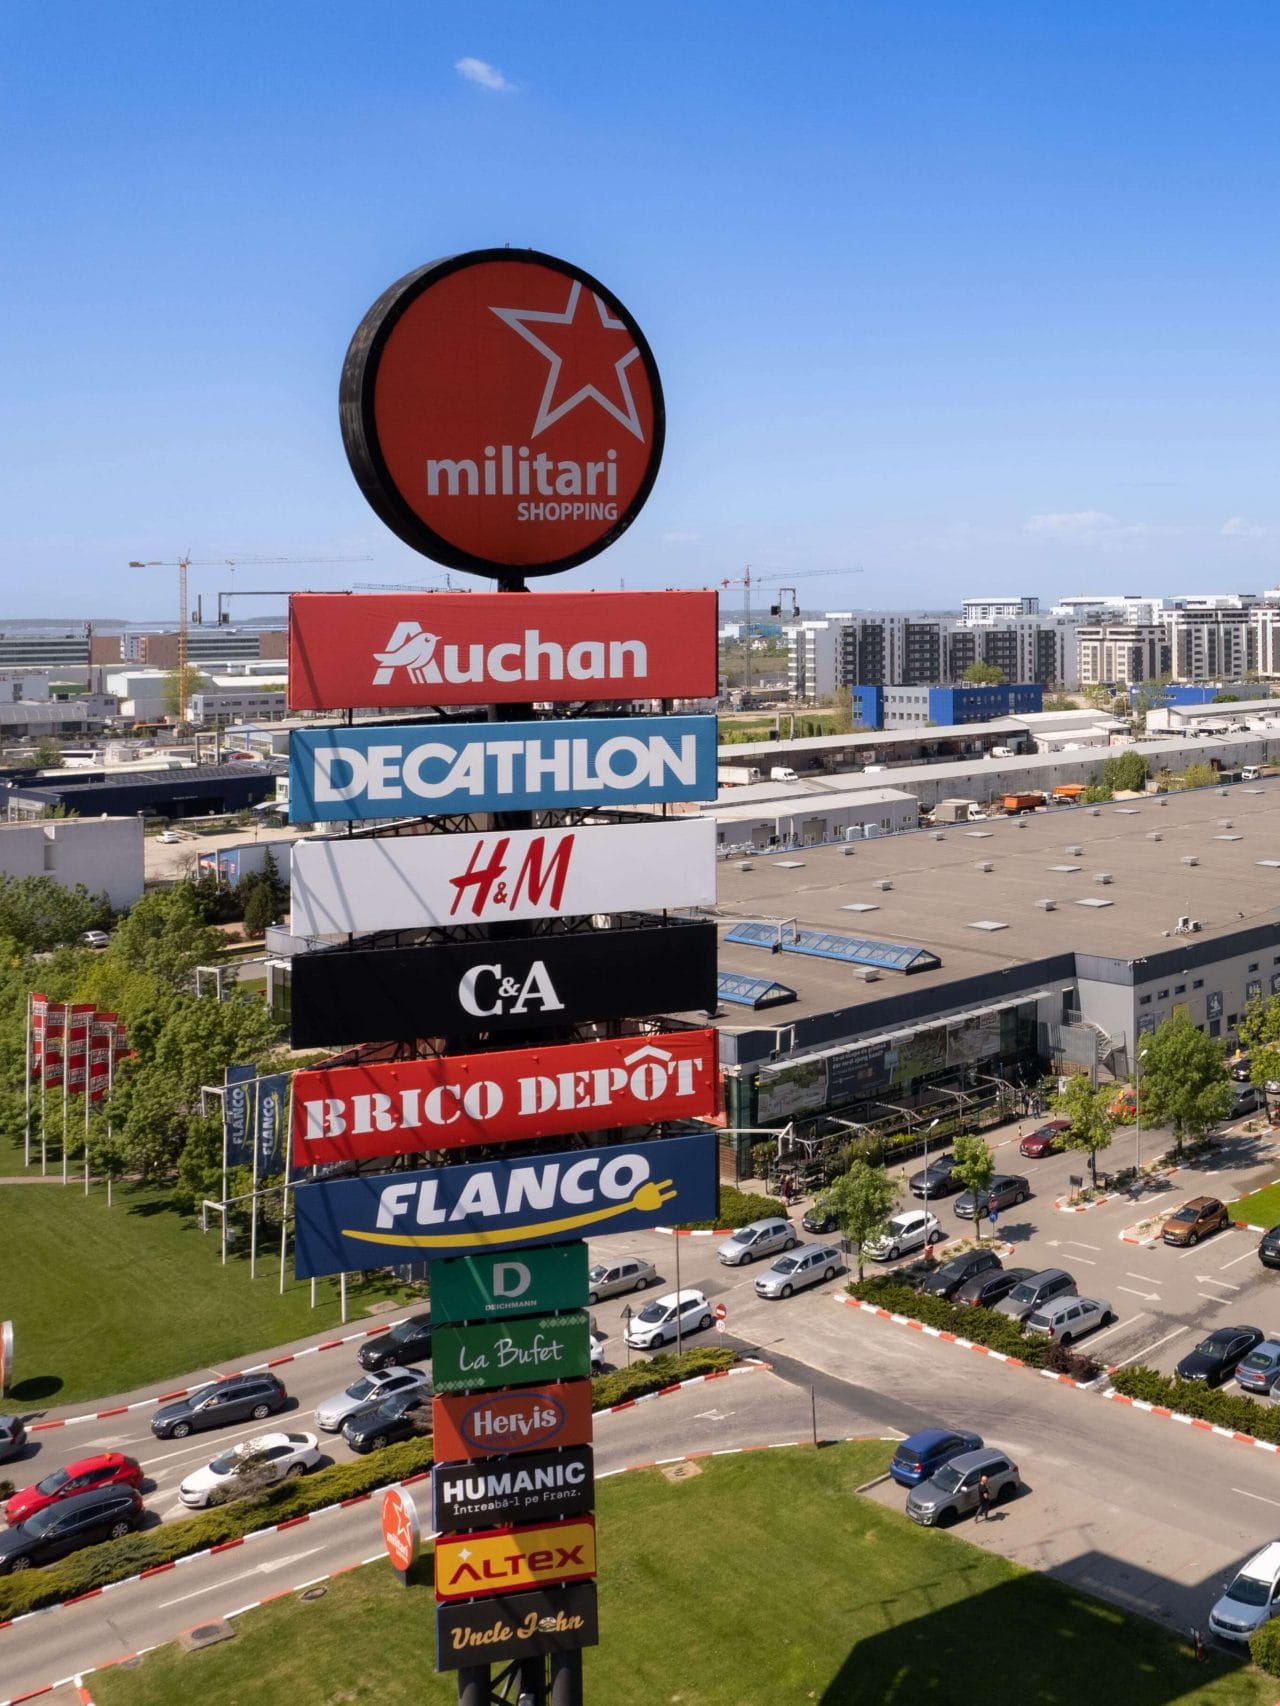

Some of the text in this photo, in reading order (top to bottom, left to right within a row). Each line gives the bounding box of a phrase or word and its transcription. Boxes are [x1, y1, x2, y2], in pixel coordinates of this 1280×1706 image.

[427, 445, 618, 496] militari
[517, 502, 618, 521] SHOPPING
[372, 621, 648, 686] Auchan
[313, 734, 697, 802] DECATHLON
[449, 834, 575, 917] H&M
[458, 961, 565, 1017] C&A
[232, 1087, 245, 1145] FLANCO
[262, 1096, 275, 1155] FLANCO
[303, 1080, 504, 1141] BRICO
[376, 1154, 651, 1230] FLANCO
[493, 1261, 532, 1298] D
[485, 1300, 538, 1311] DEICHMANN
[459, 1334, 564, 1372] La Bufet
[473, 1406, 557, 1437] Hervis
[443, 1462, 586, 1504] HUMANIC
[525, 1495, 539, 1506] pe
[543, 1489, 581, 1502] Franz.
[451, 1620, 513, 1650] Uncle
